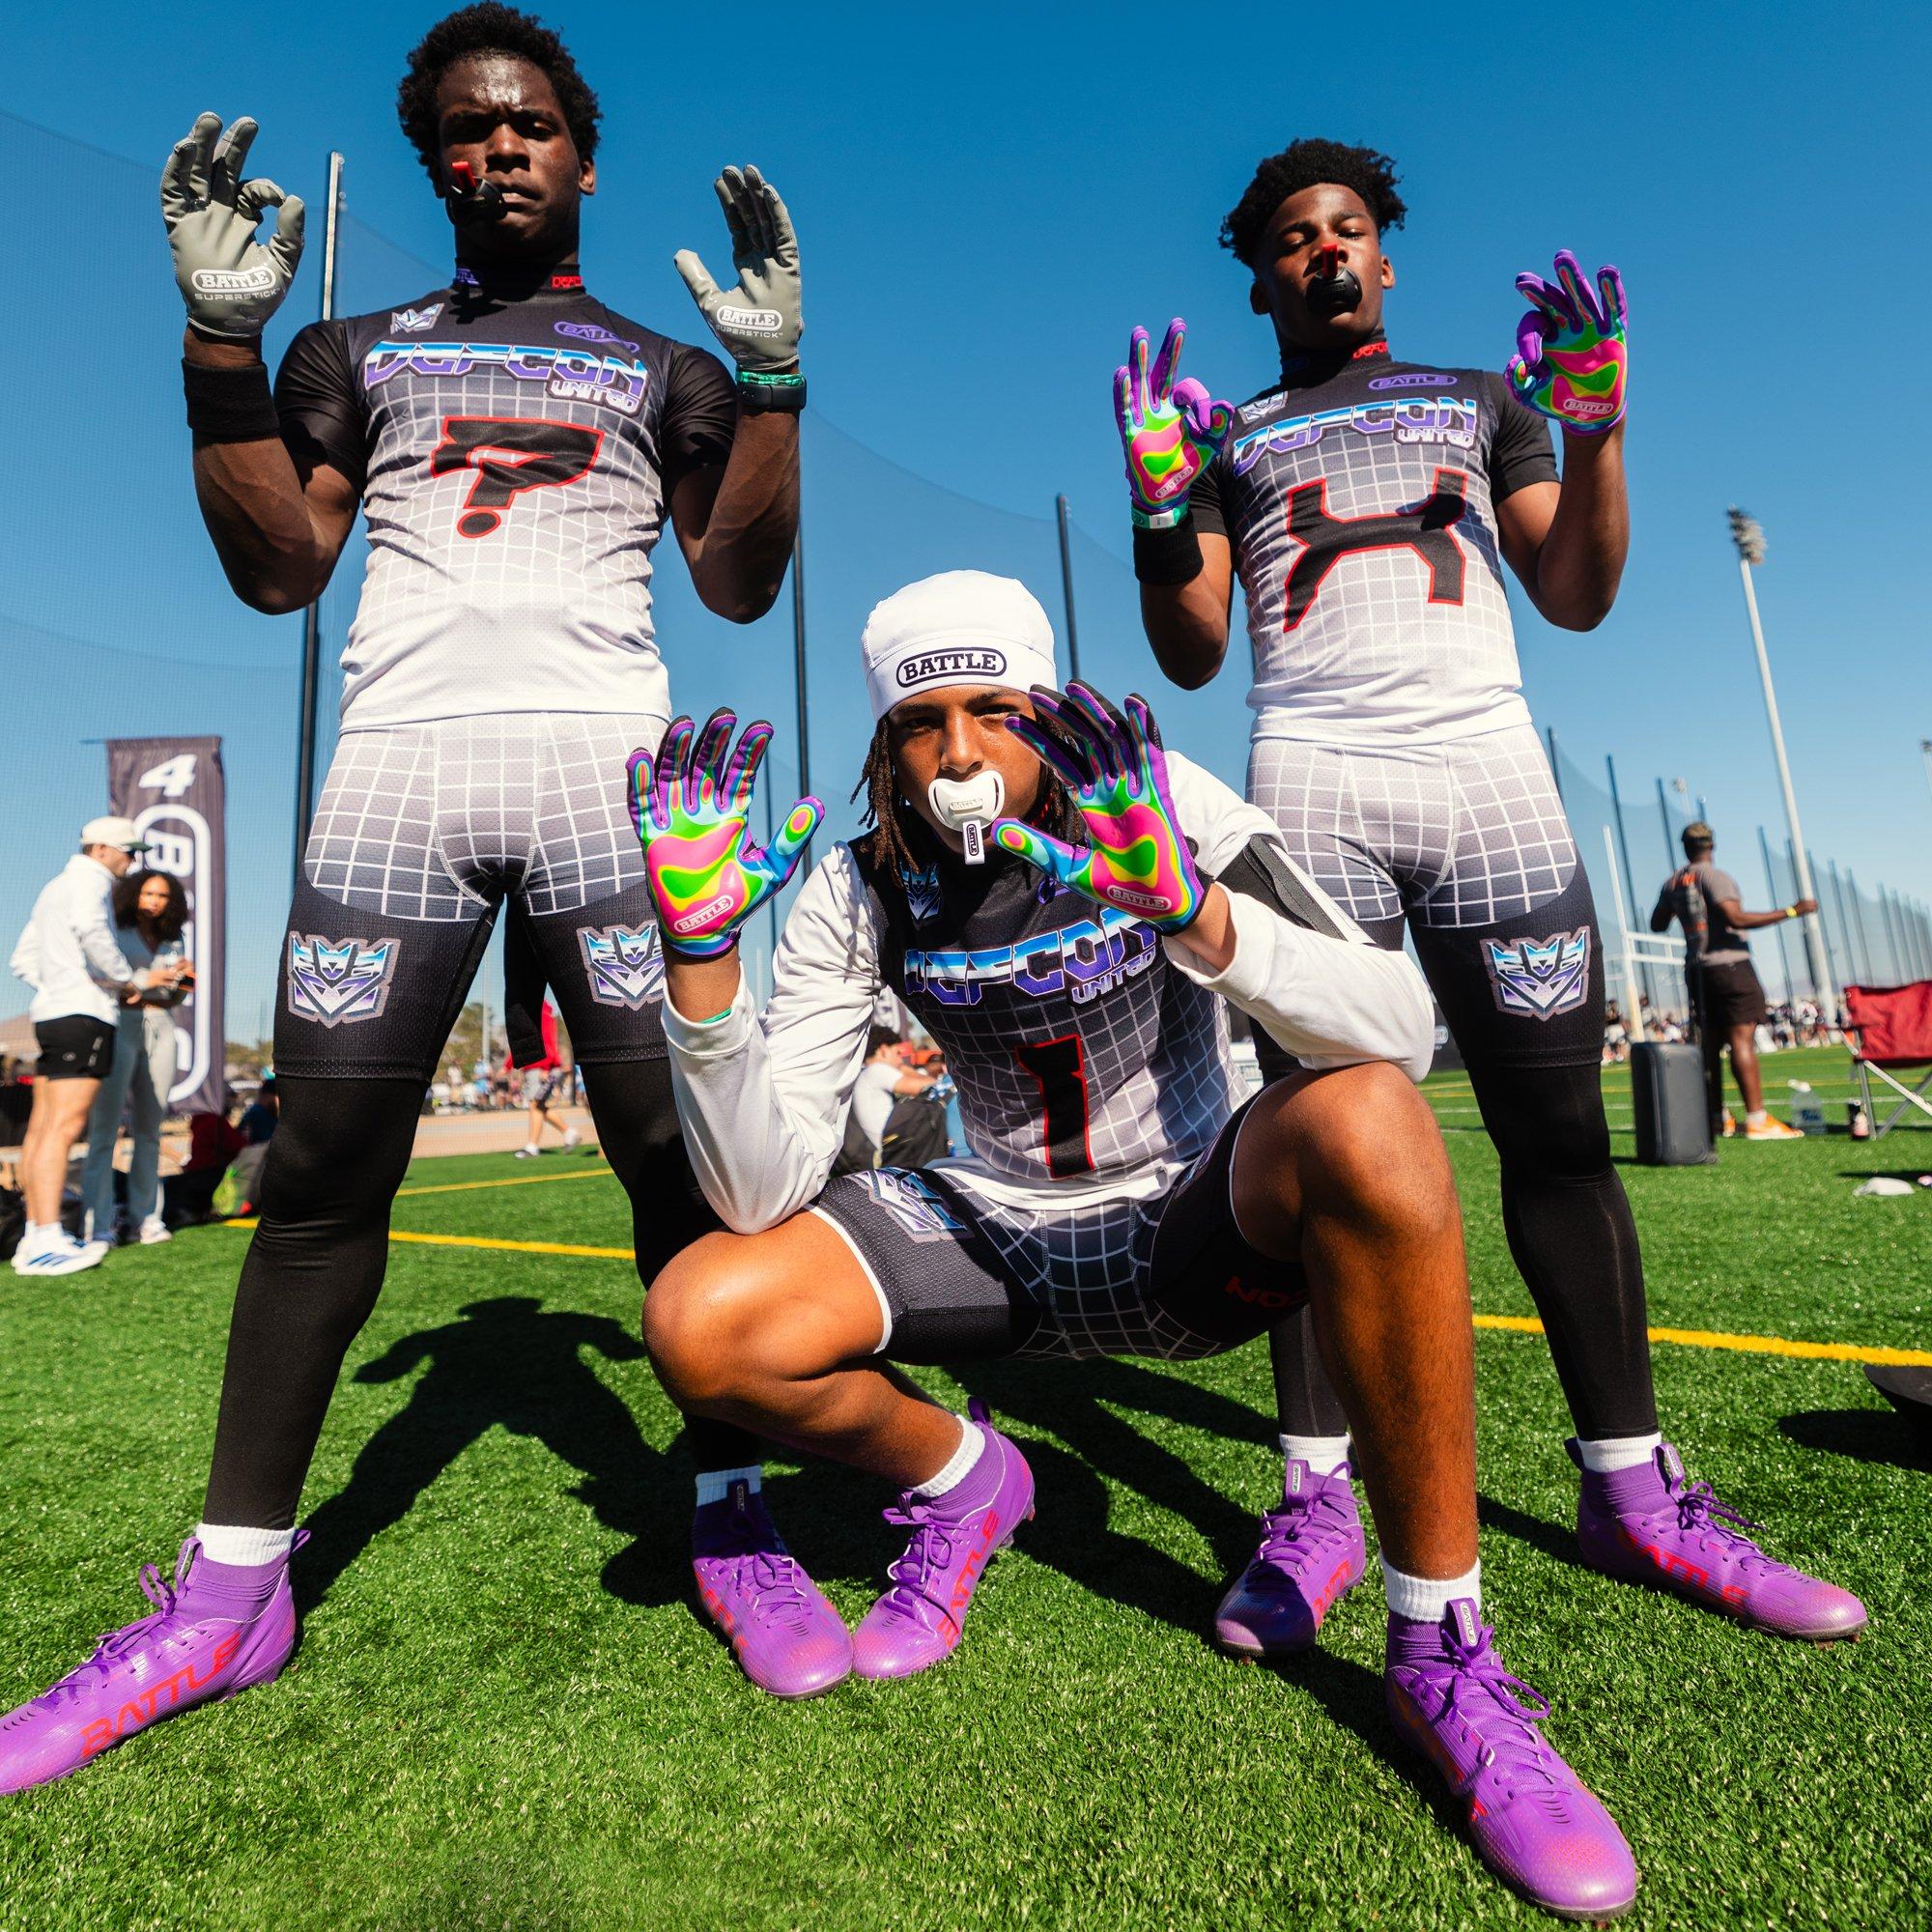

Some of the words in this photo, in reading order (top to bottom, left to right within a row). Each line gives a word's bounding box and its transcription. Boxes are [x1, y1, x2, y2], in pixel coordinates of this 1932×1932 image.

[199, 270, 270, 289] BATTLE
[194, 289, 277, 301] SUPERSTICK
[721, 309, 776, 327] BATTLE
[1378, 375, 1450, 388] BATTLE
[550, 380, 640, 413] UNITED
[1567, 400, 1610, 412] BATTLE
[1398, 428, 1475, 449] UNITED
[903, 652, 998, 682] BATTLE
[968, 826, 978, 854] BATTLE
[1112, 887, 1166, 909] BATTLE
[678, 897, 730, 931] BATTLE
[1071, 945, 1156, 1005] UNITED
[1016, 1034, 1096, 1180] 1
[1463, 1606, 1475, 1641] BATTLE
[79, 1630, 242, 1759] BATTLE
